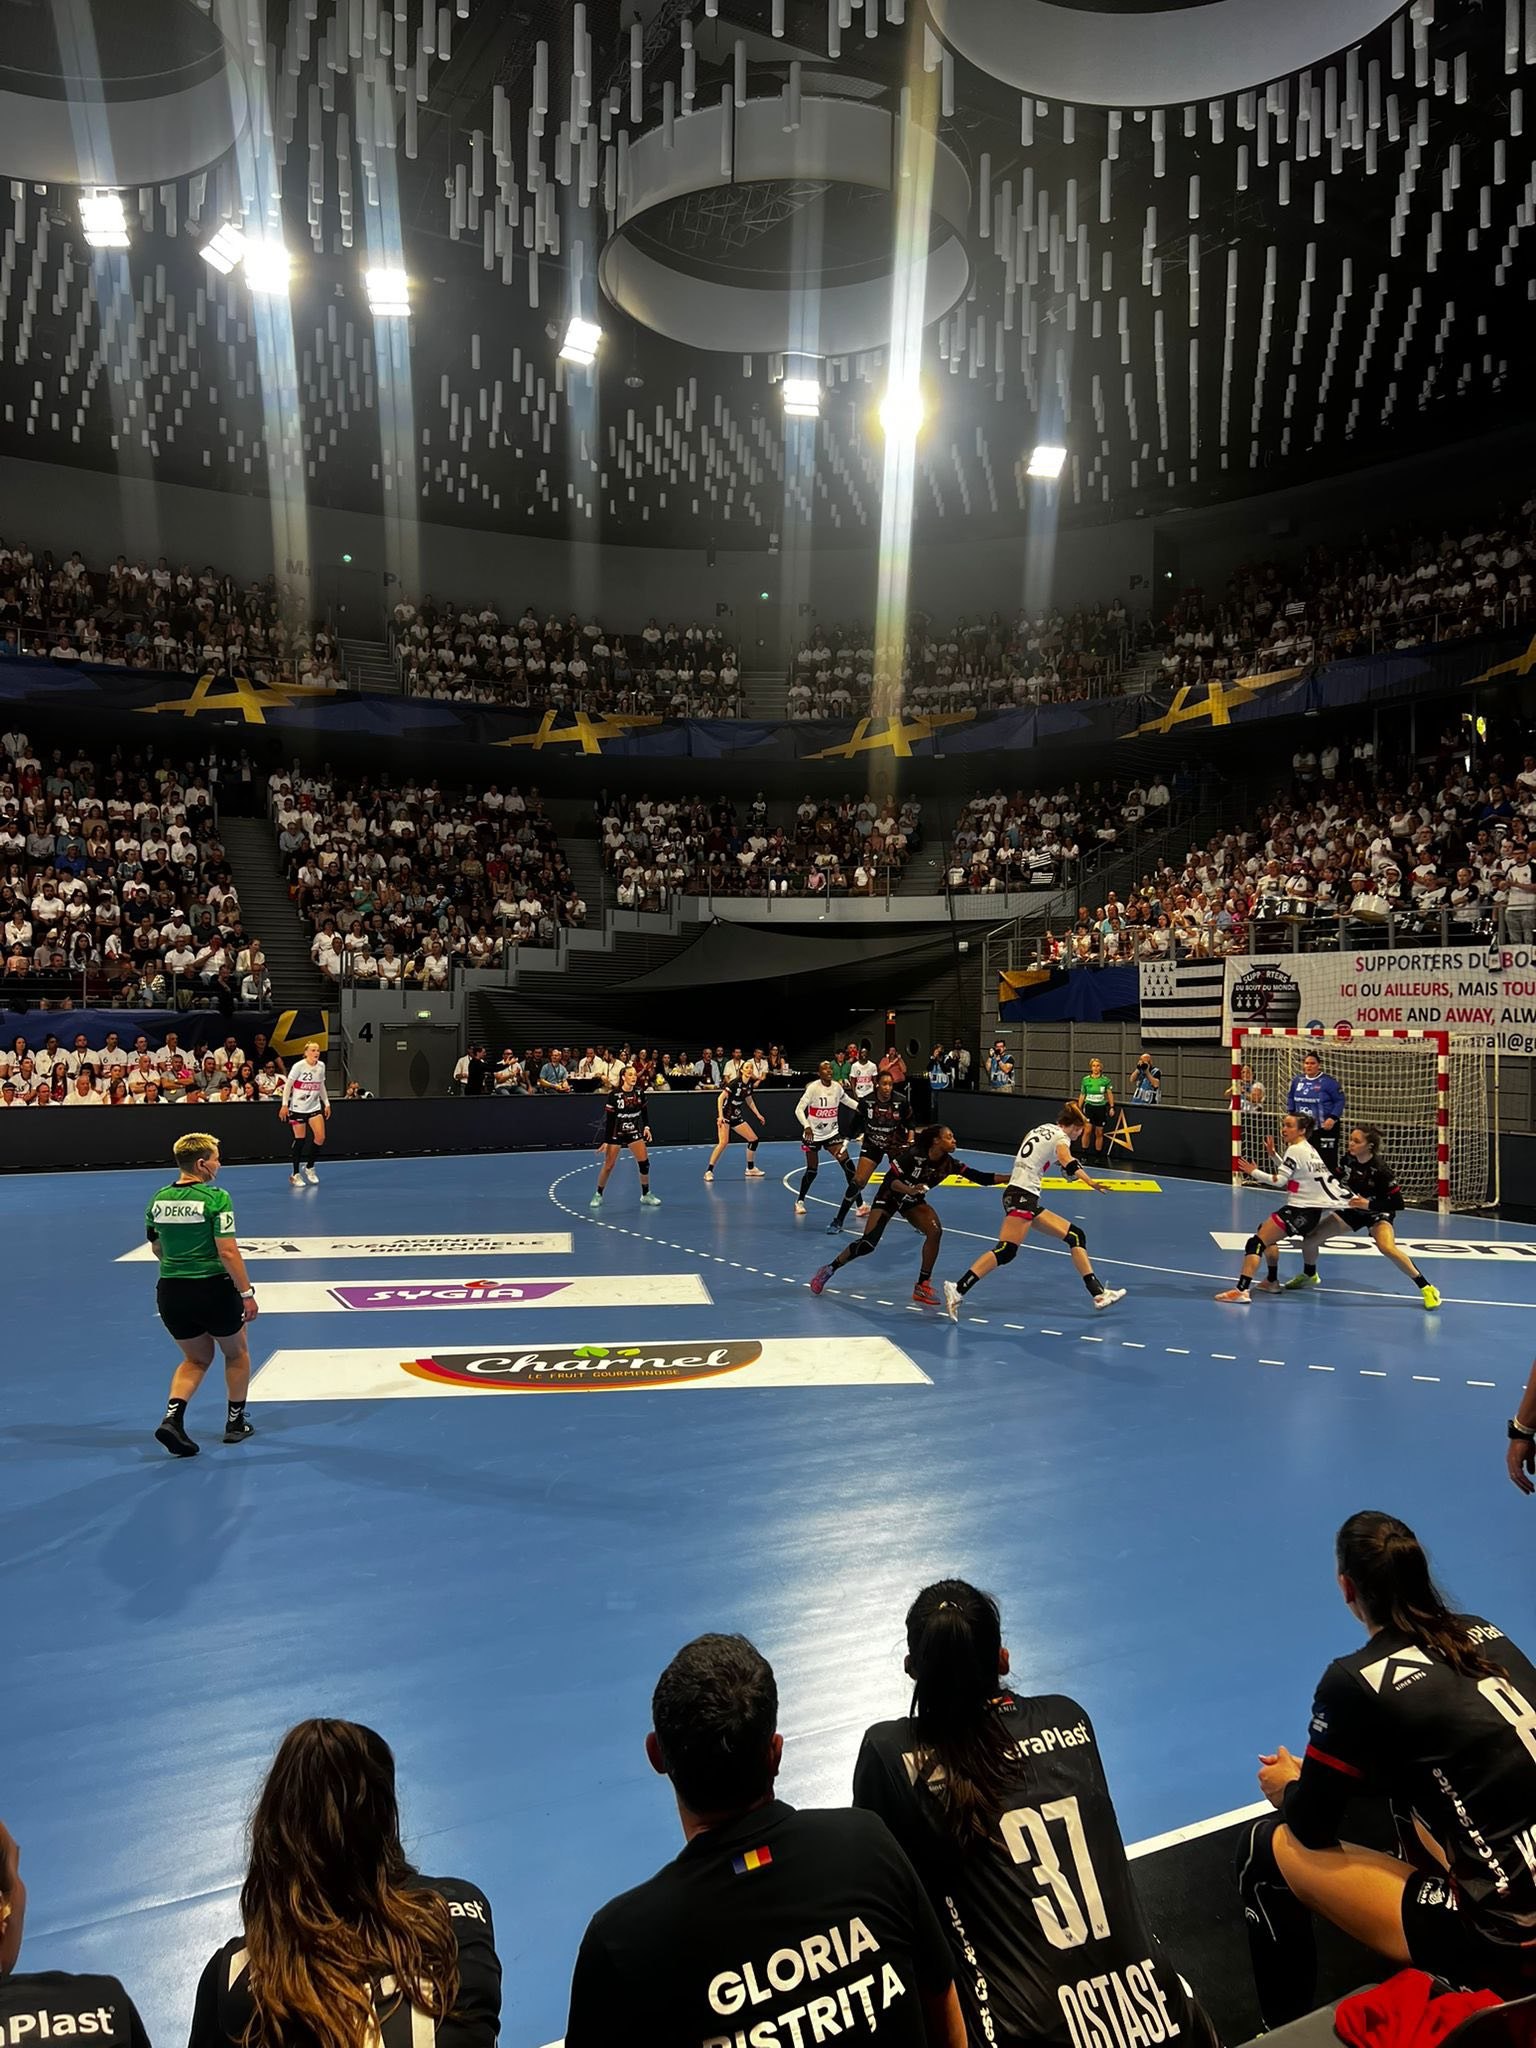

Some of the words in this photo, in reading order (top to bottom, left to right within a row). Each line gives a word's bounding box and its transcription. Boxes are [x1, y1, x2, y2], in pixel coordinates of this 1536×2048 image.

[1355, 952, 1463, 972] SUPPORTERS
[1341, 984, 1357, 997] ICI
[1360, 984, 1382, 997] OU
[1384, 982, 1453, 999] AILLEURS,
[1458, 982, 1498, 996] MAIS
[1357, 1007, 1402, 1022] HOME
[1407, 1007, 1441, 1022] AND
[1445, 1008, 1496, 1025] AWAY,
[358, 1022, 374, 1043] 4
[302, 1072, 313, 1081] 23
[818, 1097, 828, 1107] 11
[1020, 1135, 1040, 1159] 6
[164, 1205, 201, 1217] DEKRA
[366, 1287, 524, 1302] SYGIA
[464, 1348, 732, 1374] Charnel
[549, 1371, 586, 1380] FRUIT
[999, 1795, 1112, 1950] 37
[707, 1916, 881, 2015] GLORIA
